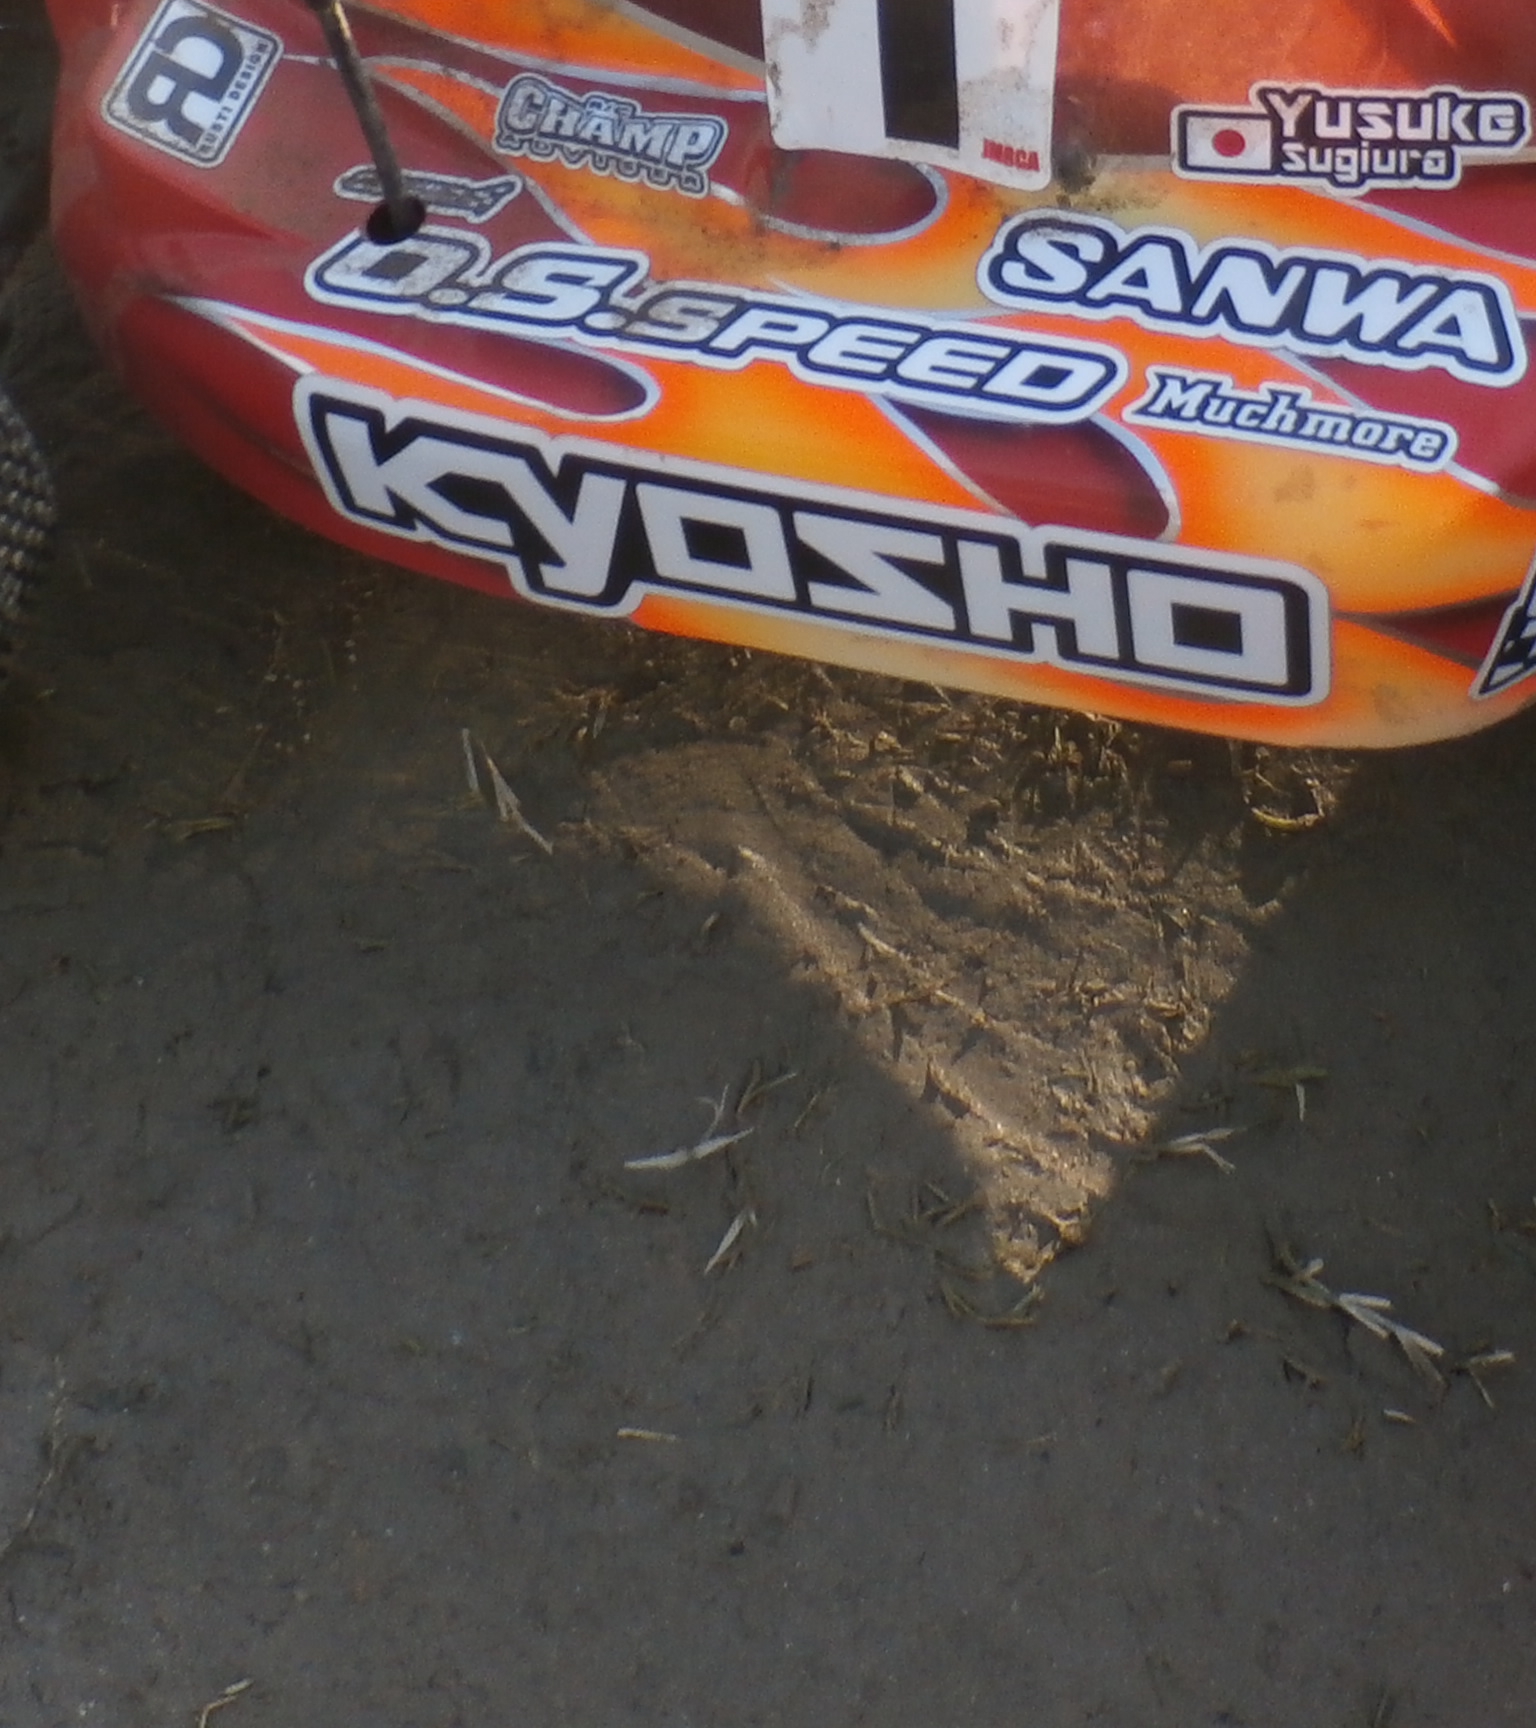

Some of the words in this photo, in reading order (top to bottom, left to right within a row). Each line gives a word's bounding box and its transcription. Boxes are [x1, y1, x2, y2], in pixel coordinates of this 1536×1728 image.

[228, 40, 269, 102] DESIGN
[505, 83, 717, 168] CHAMP
[1266, 91, 1519, 142] Yusuke
[996, 222, 1504, 375] SANWA
[1146, 374, 1446, 459] Muchmore
[323, 398, 1294, 696] KYOSHO
